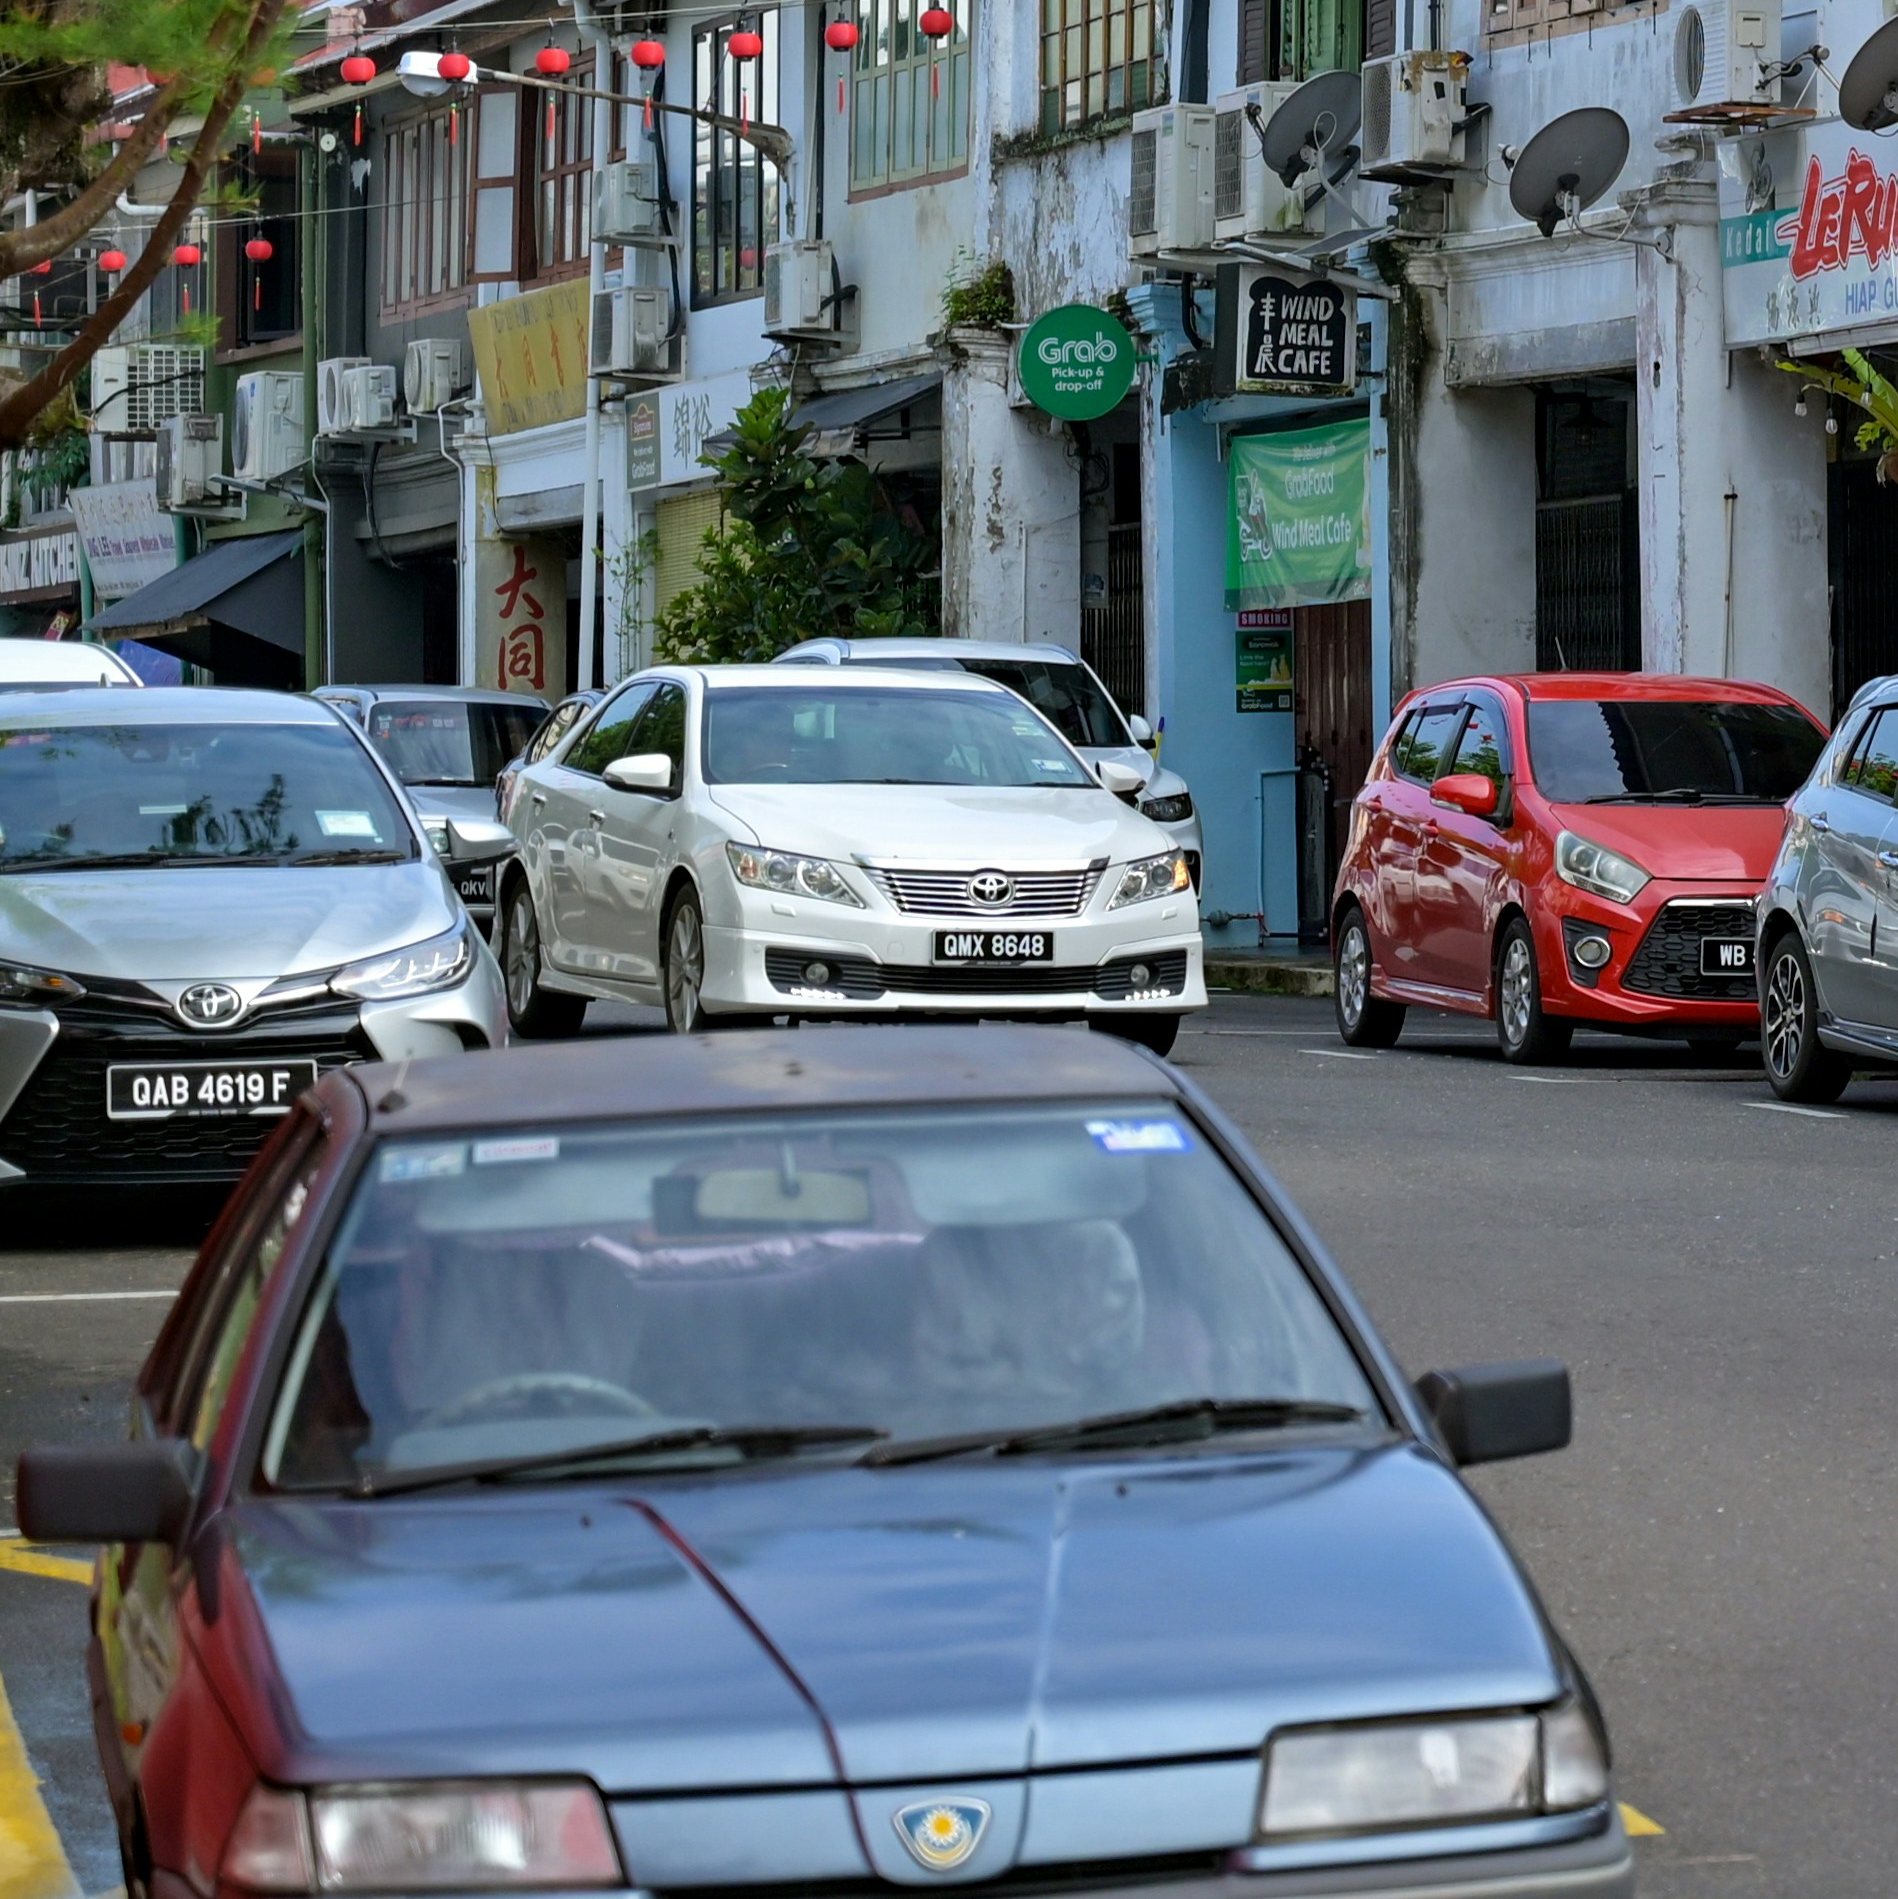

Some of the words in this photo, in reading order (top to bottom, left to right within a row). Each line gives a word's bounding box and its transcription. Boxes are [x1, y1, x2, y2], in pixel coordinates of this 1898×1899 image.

[1726, 220, 1770, 259] Kedai
[1281, 293, 1334, 321] WIND
[1844, 276, 1877, 315] HIAP
[1038, 331, 1117, 364] Grab
[1278, 322, 1334, 347] MEAL
[1051, 367, 1093, 379] Pick-up
[1095, 365, 1105, 377] &
[1277, 348, 1331, 375] CAFE
[1054, 380, 1103, 393] drop-off
[1285, 463, 1335, 499] GrabFood
[1271, 519, 1298, 550] Wind
[1300, 515, 1325, 546] Meal
[1327, 512, 1351, 544] Cafe
[495, 545, 545, 691] 大同
[1241, 613, 1288, 625] SMOKING
[461, 880, 486, 896] QKV
[944, 934, 985, 957] QMX
[991, 934, 1045, 957] 8648
[1720, 944, 1746, 966] WB
[132, 1073, 189, 1107] QAB
[197, 1072, 264, 1105] 4619
[272, 1070, 291, 1102] F
